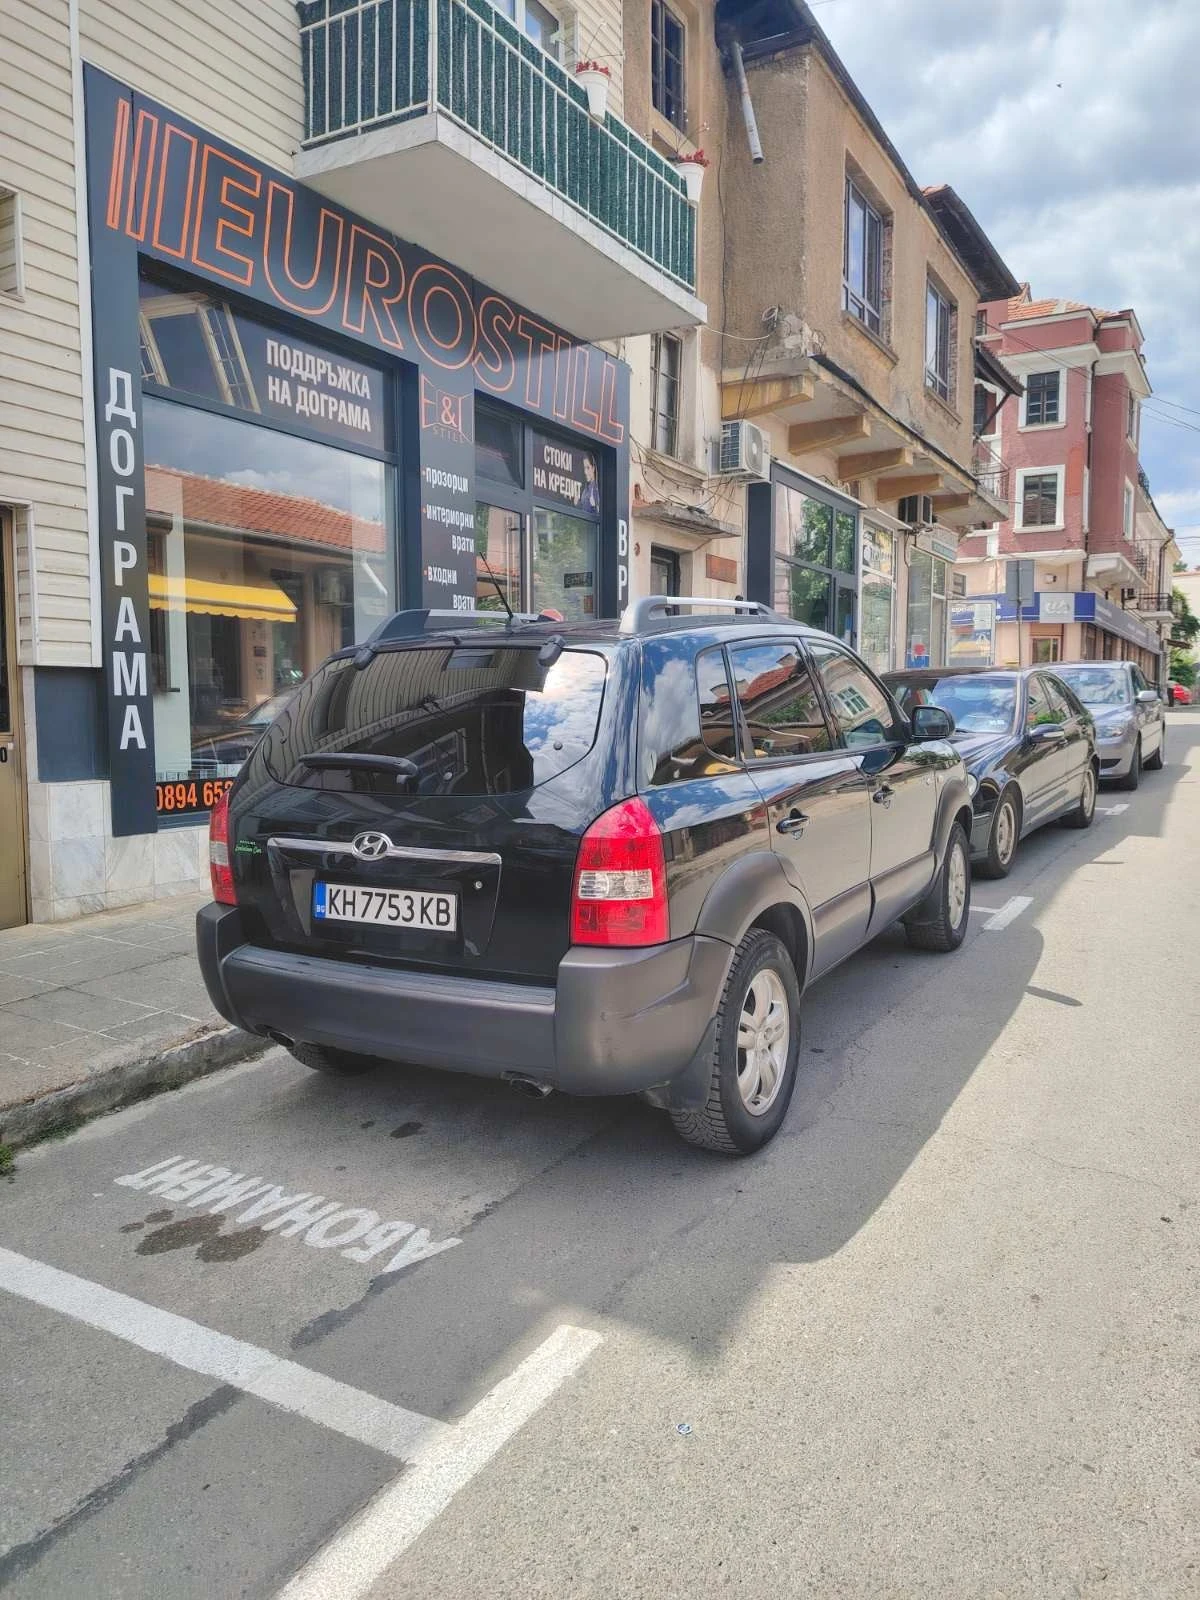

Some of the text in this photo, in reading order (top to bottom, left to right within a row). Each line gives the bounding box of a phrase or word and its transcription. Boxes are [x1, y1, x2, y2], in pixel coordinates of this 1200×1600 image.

[266, 339, 371, 400] ПОДДРЪЖКА
[268, 375, 371, 433] НА ДОГРАМА
[543, 445, 573, 472] СТОКИ
[425, 467, 469, 493] прозорци
[533, 467, 582, 500] НА КРЕДИТ
[104, 366, 147, 750] ДОГРАМА
[451, 535, 475, 555] врати
[427, 566, 458, 585] входни
[453, 594, 475, 611] врати
[114, 1155, 463, 1273] АБОНАМЕНТ
